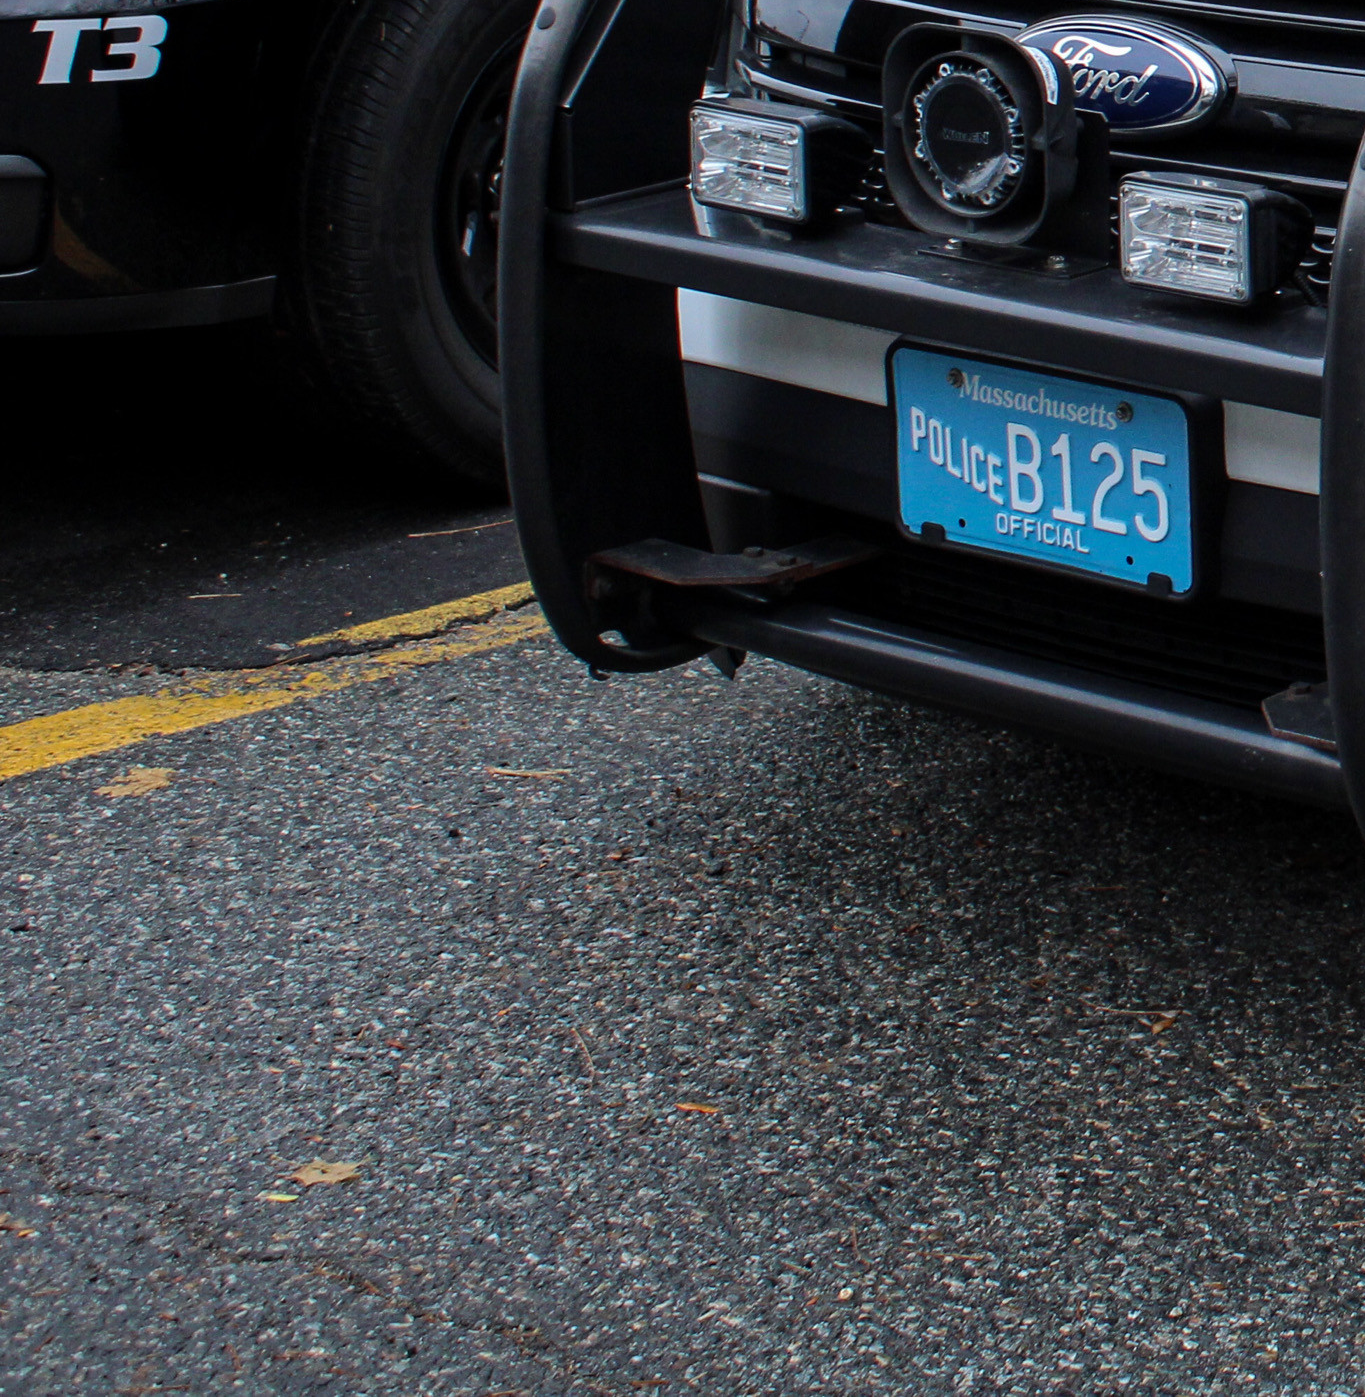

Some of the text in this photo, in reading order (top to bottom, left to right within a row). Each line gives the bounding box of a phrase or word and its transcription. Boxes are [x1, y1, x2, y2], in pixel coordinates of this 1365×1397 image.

[30, 15, 168, 84] T3
[1053, 35, 1159, 106] Ford
[959, 372, 1118, 430] Massachusetts
[910, 406, 1169, 542] POLICE B125
[996, 512, 1090, 553] OFFICIAL
